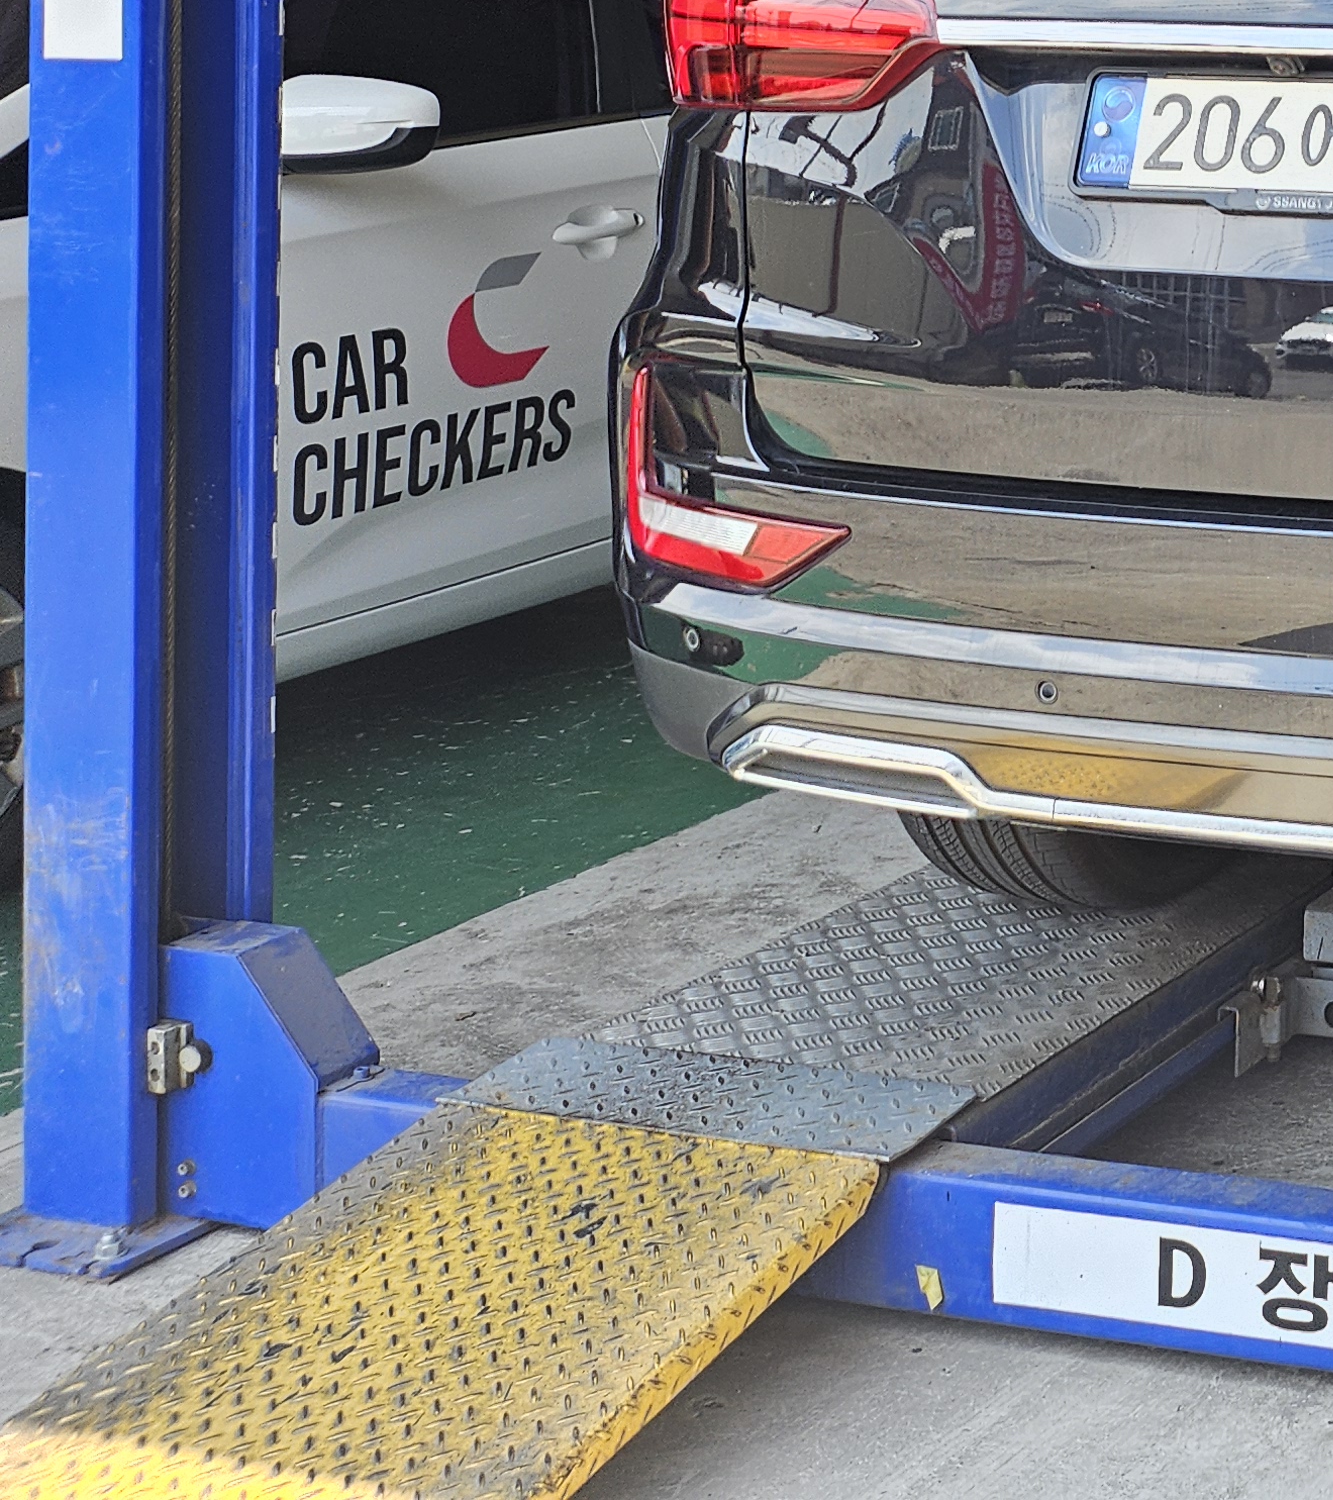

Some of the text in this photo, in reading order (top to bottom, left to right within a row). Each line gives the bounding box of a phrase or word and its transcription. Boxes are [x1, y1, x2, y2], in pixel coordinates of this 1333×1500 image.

[1085, 152, 1129, 175] KOR
[292, 328, 409, 424] CAR
[293, 389, 576, 526] CHECKERS
